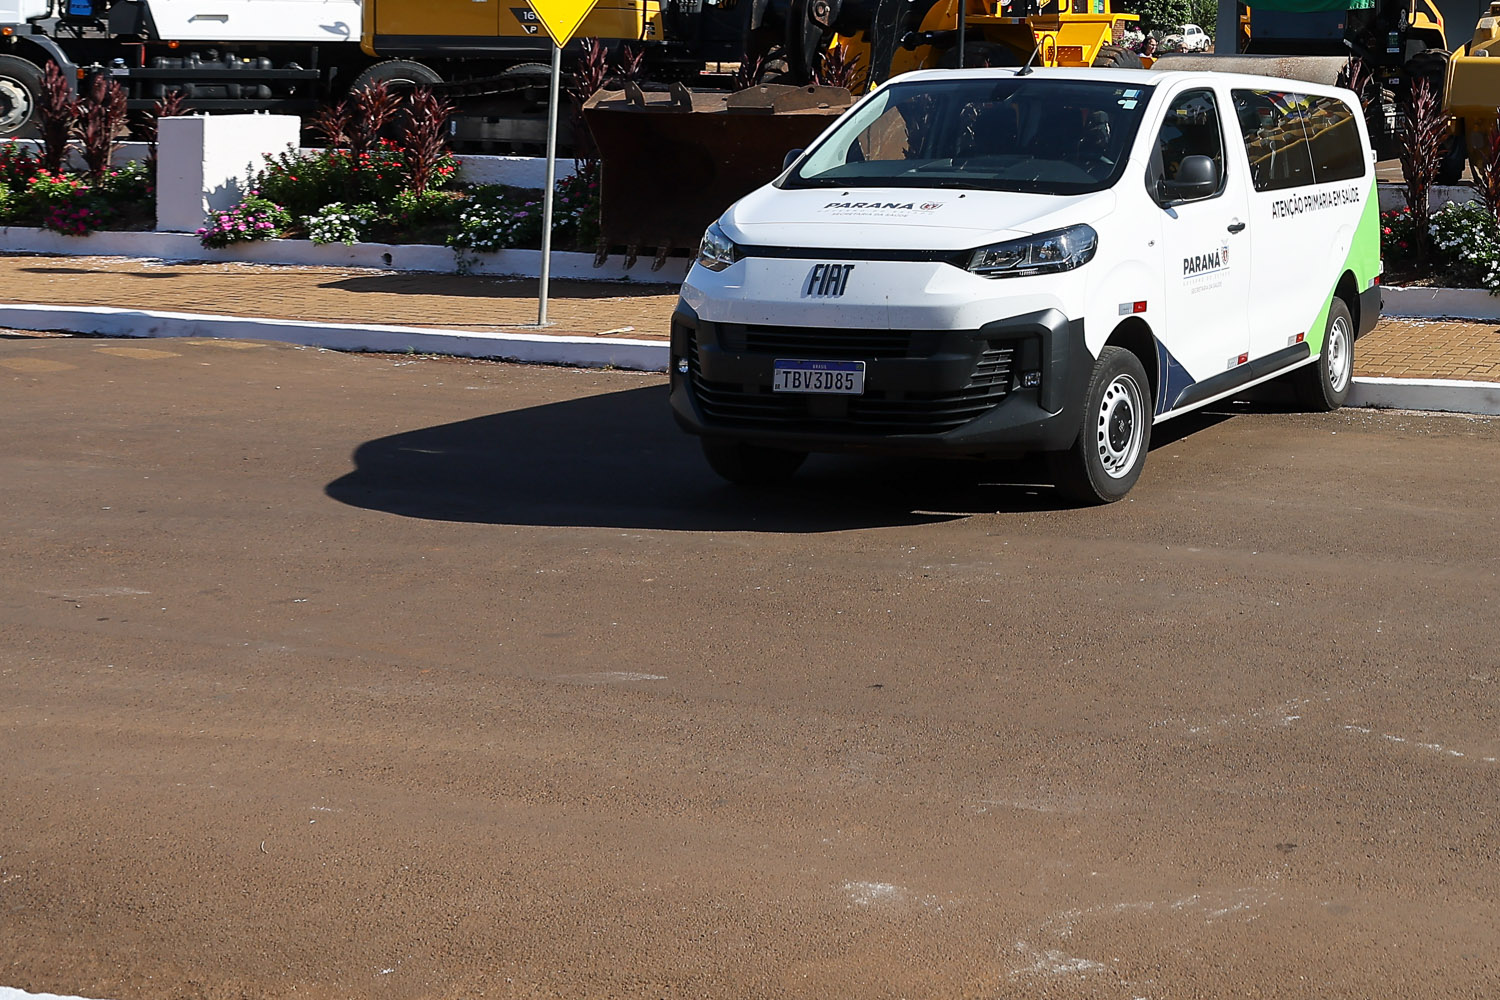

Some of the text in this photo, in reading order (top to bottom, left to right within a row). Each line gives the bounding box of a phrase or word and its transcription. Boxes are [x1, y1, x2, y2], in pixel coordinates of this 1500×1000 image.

[1272, 193, 1304, 220] ATENÇÃO
[1304, 189, 1333, 213] PRIMÁRIA
[1332, 190, 1342, 207] EM
[1183, 248, 1221, 275] PARANÁ
[807, 263, 855, 296] FIAT
[782, 371, 854, 391] TBV3D85
